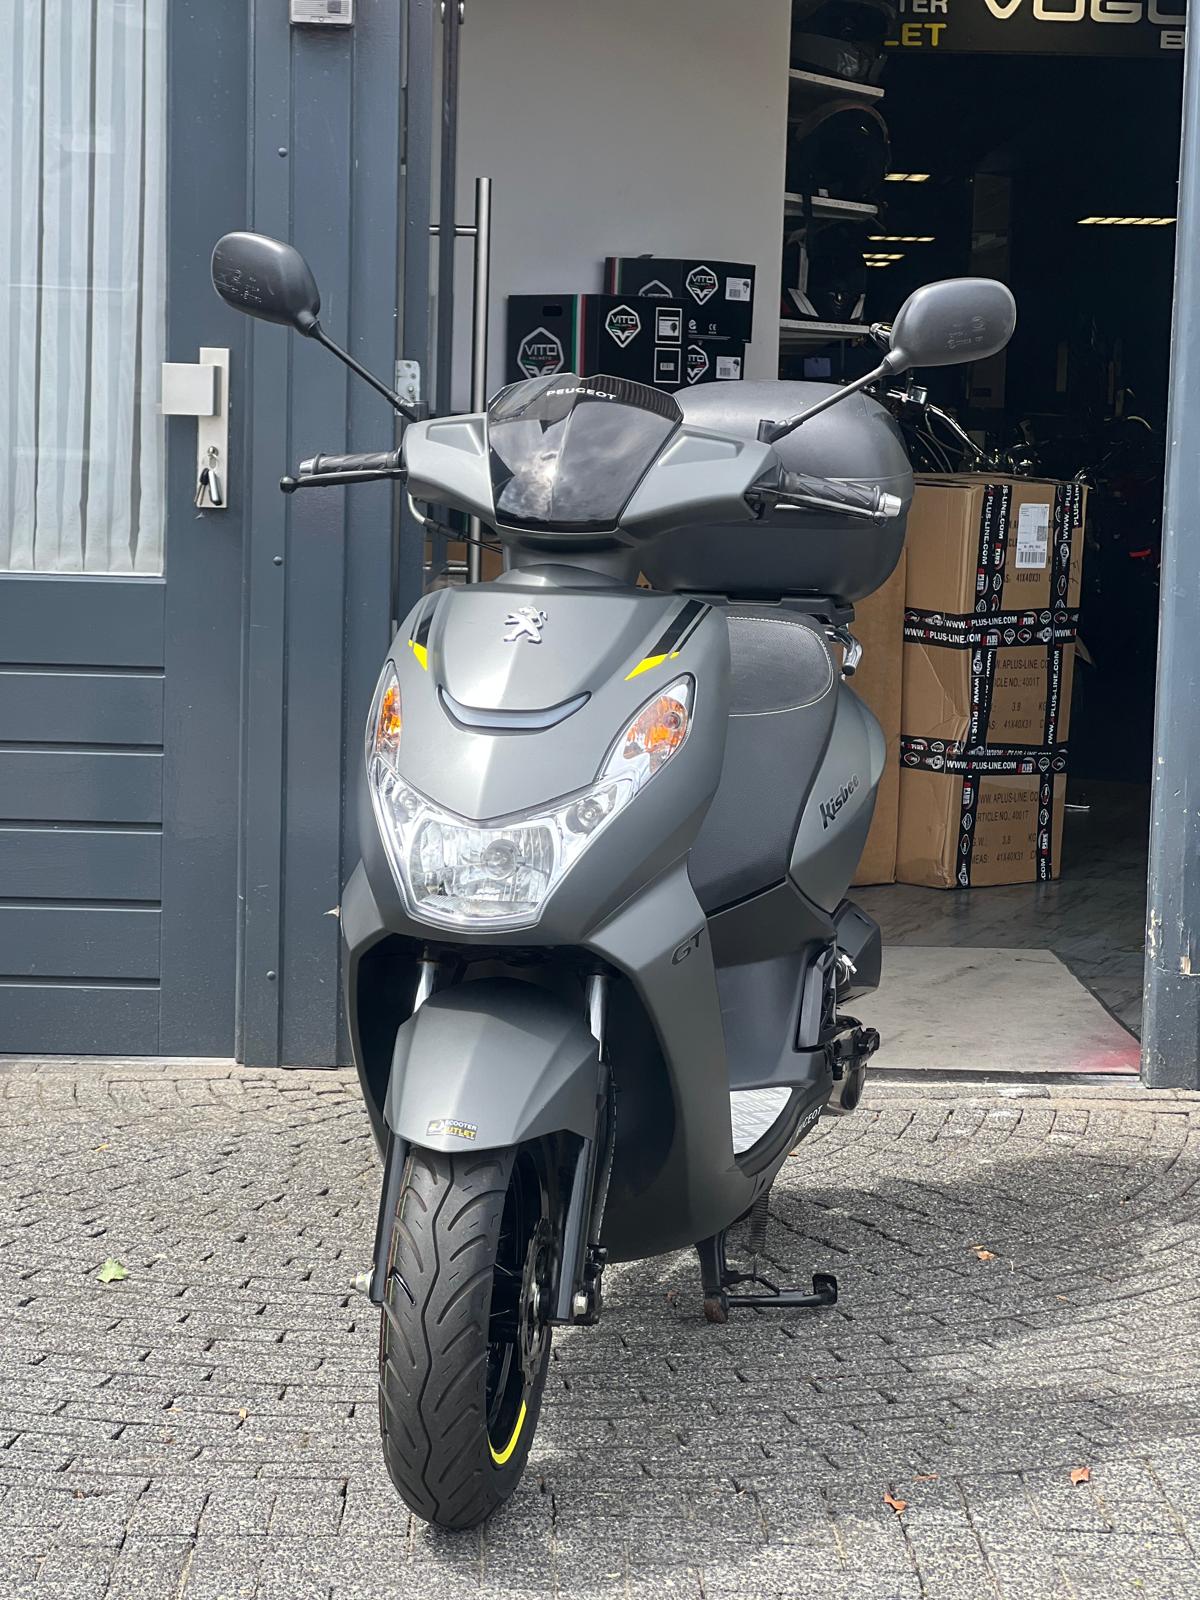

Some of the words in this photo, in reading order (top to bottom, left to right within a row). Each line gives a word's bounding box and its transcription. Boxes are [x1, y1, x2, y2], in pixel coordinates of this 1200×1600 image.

[691, 275, 714, 284] VITO
[611, 315, 636, 324] VITO
[524, 344, 558, 356] VITO
[688, 354, 705, 362] ITO
[546, 387, 617, 400] PEUGEOT
[819, 774, 859, 830] Kisbee
[671, 927, 705, 966] GT
